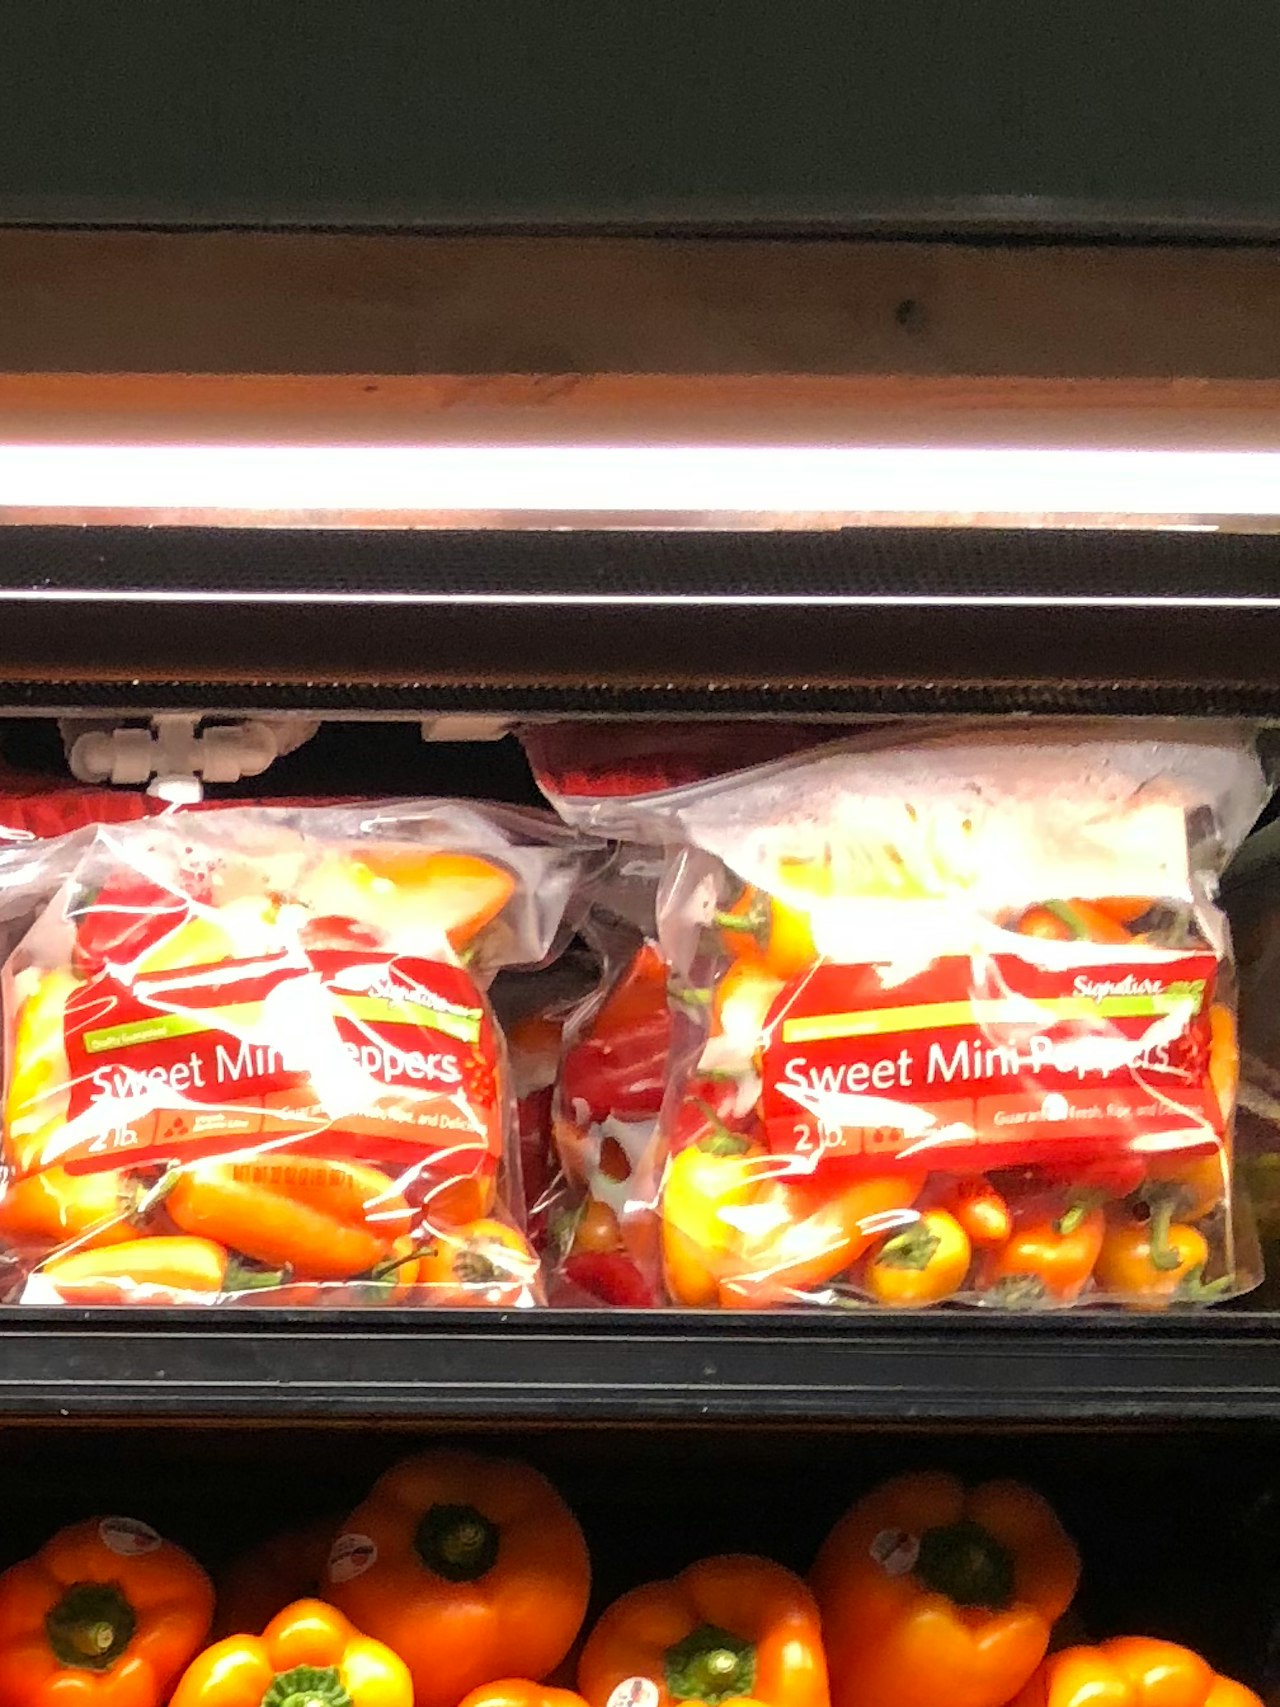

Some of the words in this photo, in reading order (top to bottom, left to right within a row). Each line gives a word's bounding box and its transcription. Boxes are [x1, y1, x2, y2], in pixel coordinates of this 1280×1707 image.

[90, 1053, 205, 1102] Sweet
[216, 1043, 290, 1083] Min
[342, 1041, 462, 1083] eppers
[784, 1050, 913, 1094] Sweet
[927, 1038, 1020, 1084] Mini
[793, 1125, 811, 1152] 2
